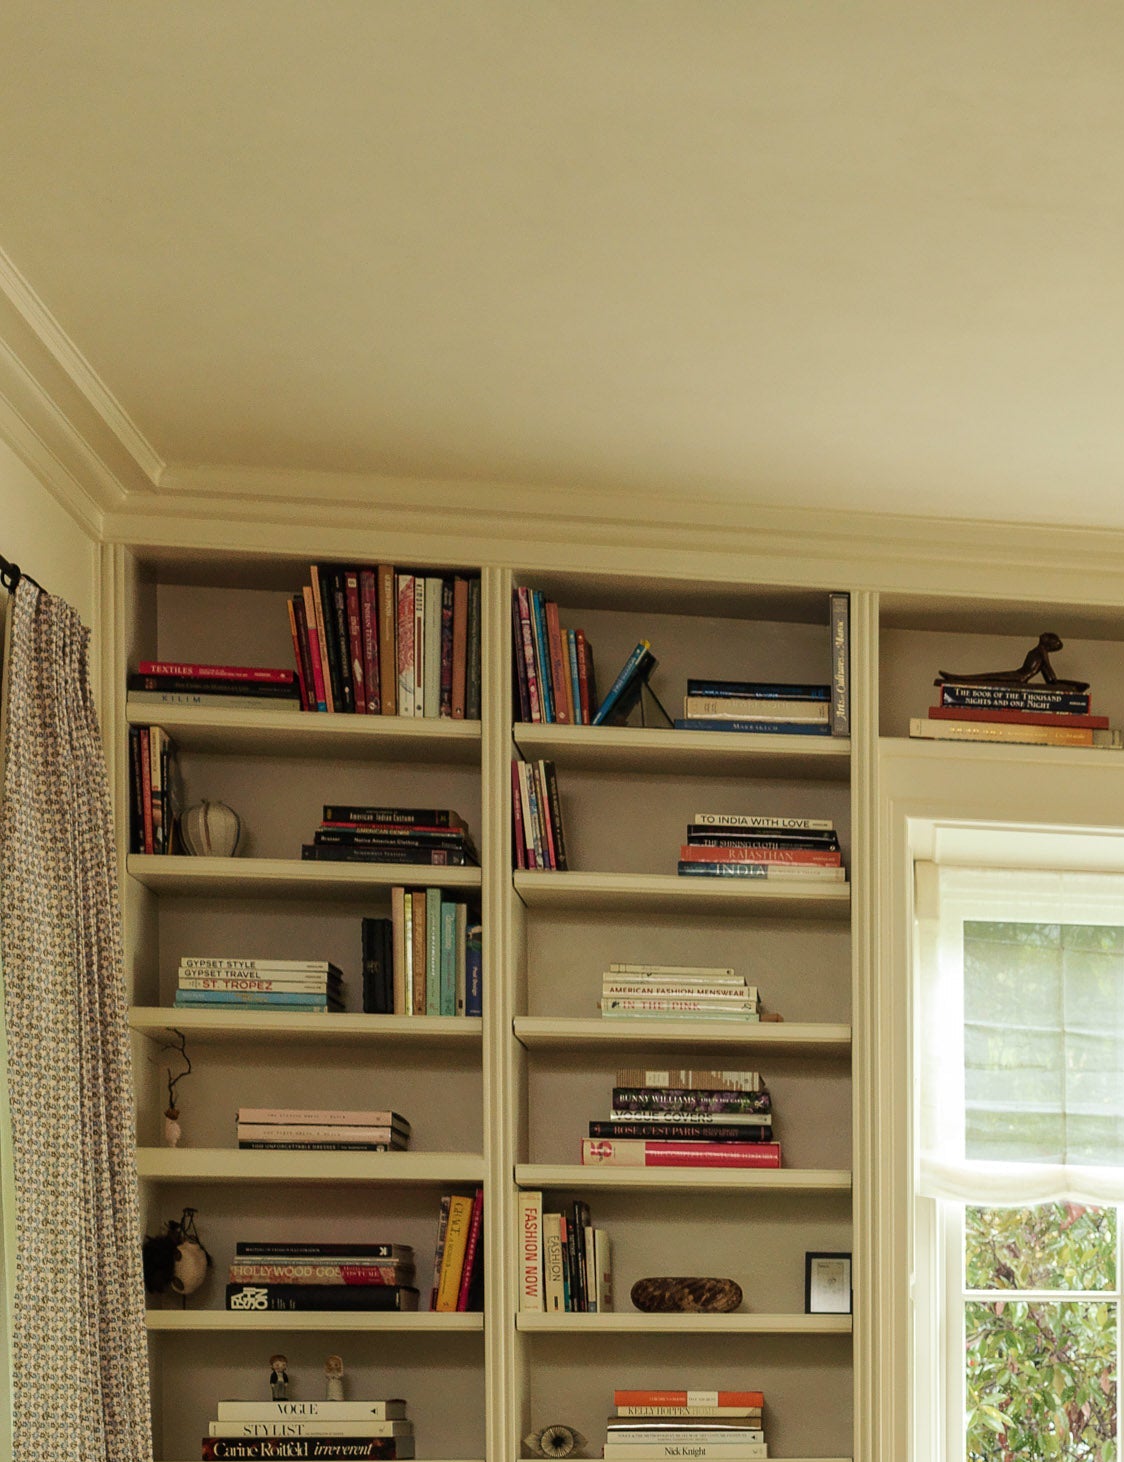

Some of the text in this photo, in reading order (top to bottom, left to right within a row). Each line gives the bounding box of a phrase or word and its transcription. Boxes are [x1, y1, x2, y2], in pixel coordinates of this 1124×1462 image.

[151, 664, 193, 675] TEXTILES
[161, 694, 201, 703] KILIM
[954, 687, 1062, 703] THE BOOK OF THE THOUSAND
[965, 696, 1050, 710] NIGHTS AND ONE NIGHT
[700, 815, 810, 829] TO INDIA WITH LOVE
[728, 849, 794, 861] RAJASTHAN
[715, 863, 766, 876] INDIA
[186, 960, 256, 969] GYPSET STYLE
[184, 969, 261, 978] GYPSET TRAVEL
[223, 980, 273, 990] TROPEZ
[609, 986, 653, 994] AMERICAN
[697, 989, 744, 997] MENSWEAR
[619, 1094, 649, 1103] BUNNY
[651, 1095, 696, 1104] WILLIAMS
[614, 1110, 714, 1123] VOGUE COVERS
[672, 1127, 701, 1137] PARIS
[524, 1207, 538, 1298] FASHION NOW
[550, 1235, 561, 1282] FASHION
[233, 1265, 312, 1277] HOLLYWOOD
[276, 1403, 319, 1415] VOGUE
[628, 1407, 655, 1415] KELLY
[656, 1407, 690, 1415] HOPPEN
[243, 1424, 305, 1436] STYLIST
[212, 1440, 374, 1458] Carine Roitfeld irreverent
[664, 1446, 706, 1458] Nick Knight
